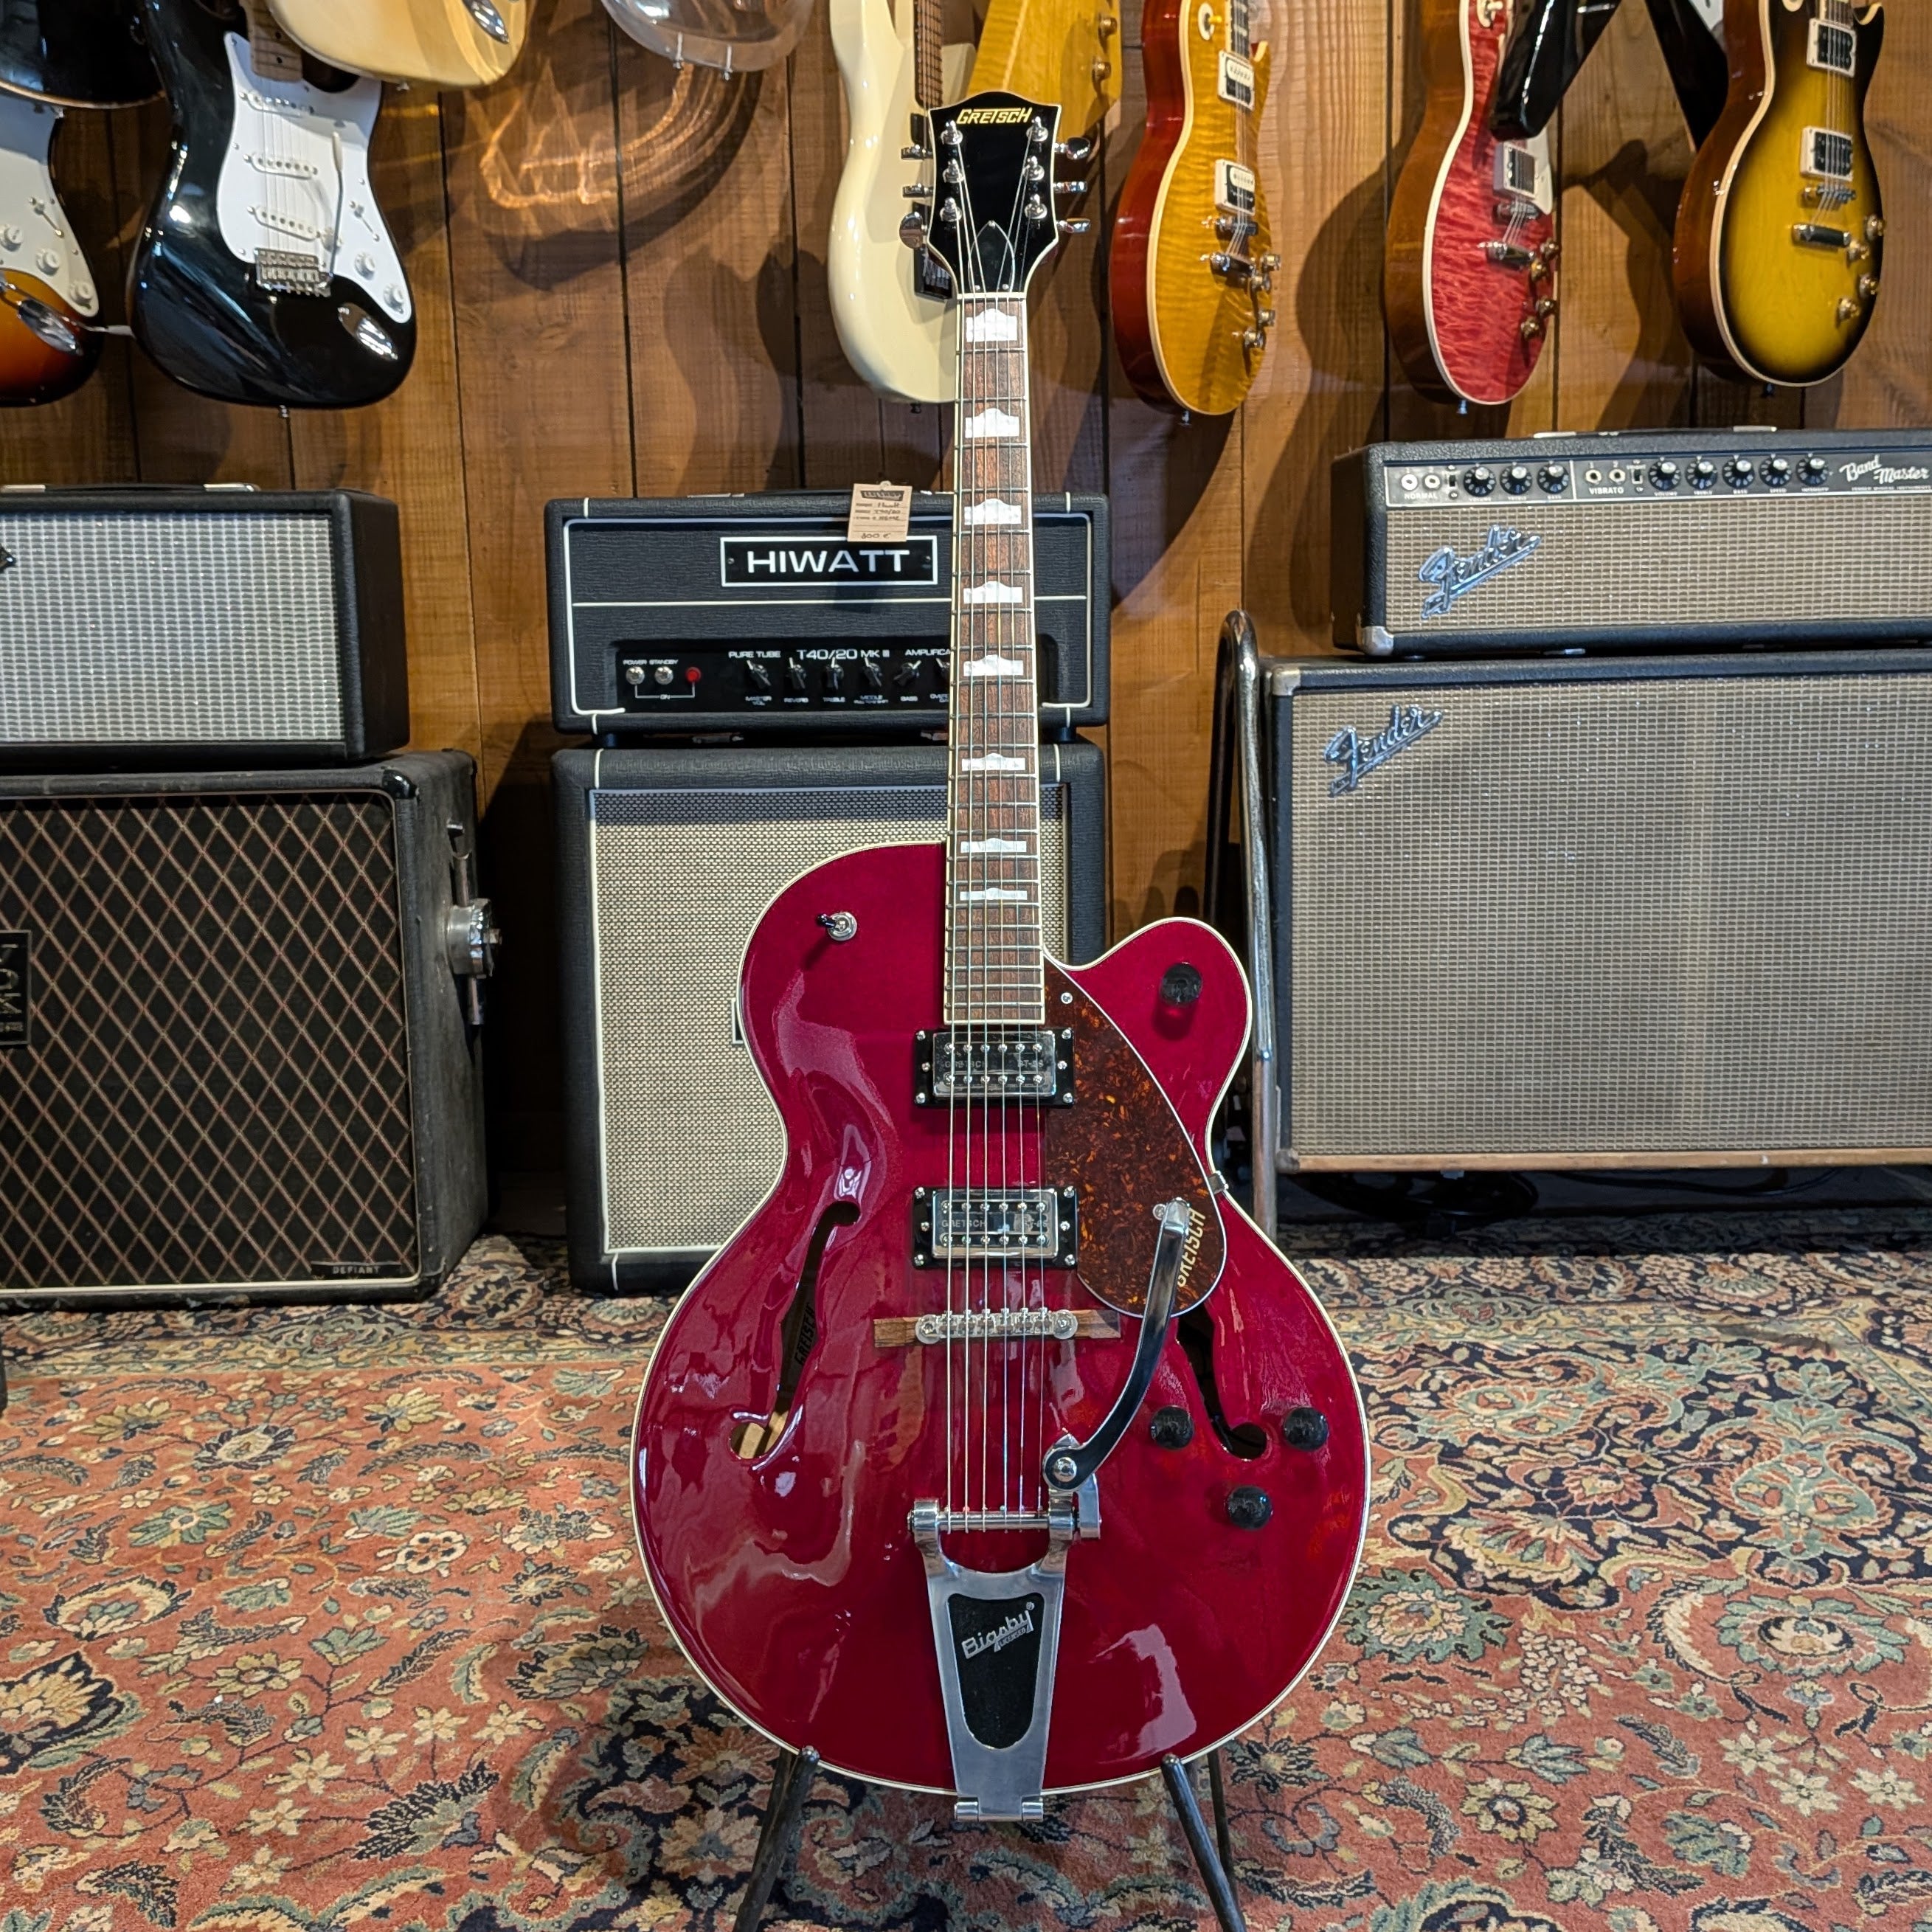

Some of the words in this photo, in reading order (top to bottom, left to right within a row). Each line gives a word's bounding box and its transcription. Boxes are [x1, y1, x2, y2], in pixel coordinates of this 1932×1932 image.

[957, 107, 1033, 125] GRETSCH
[1839, 454, 1882, 482] Band
[1873, 466, 1930, 485] Master
[1589, 487, 1624, 495] VIBRATO
[747, 550, 910, 573] HIWATT
[1418, 524, 1543, 620] Fender
[728, 651, 755, 659] PURE
[755, 650, 781, 658] TUBE
[797, 648, 858, 660] T40/20
[860, 649, 880, 657] MK
[1323, 704, 1443, 798] Fender
[333, 1266, 381, 1275] DEFIANT
[961, 1610, 1034, 1659] Bigsby
